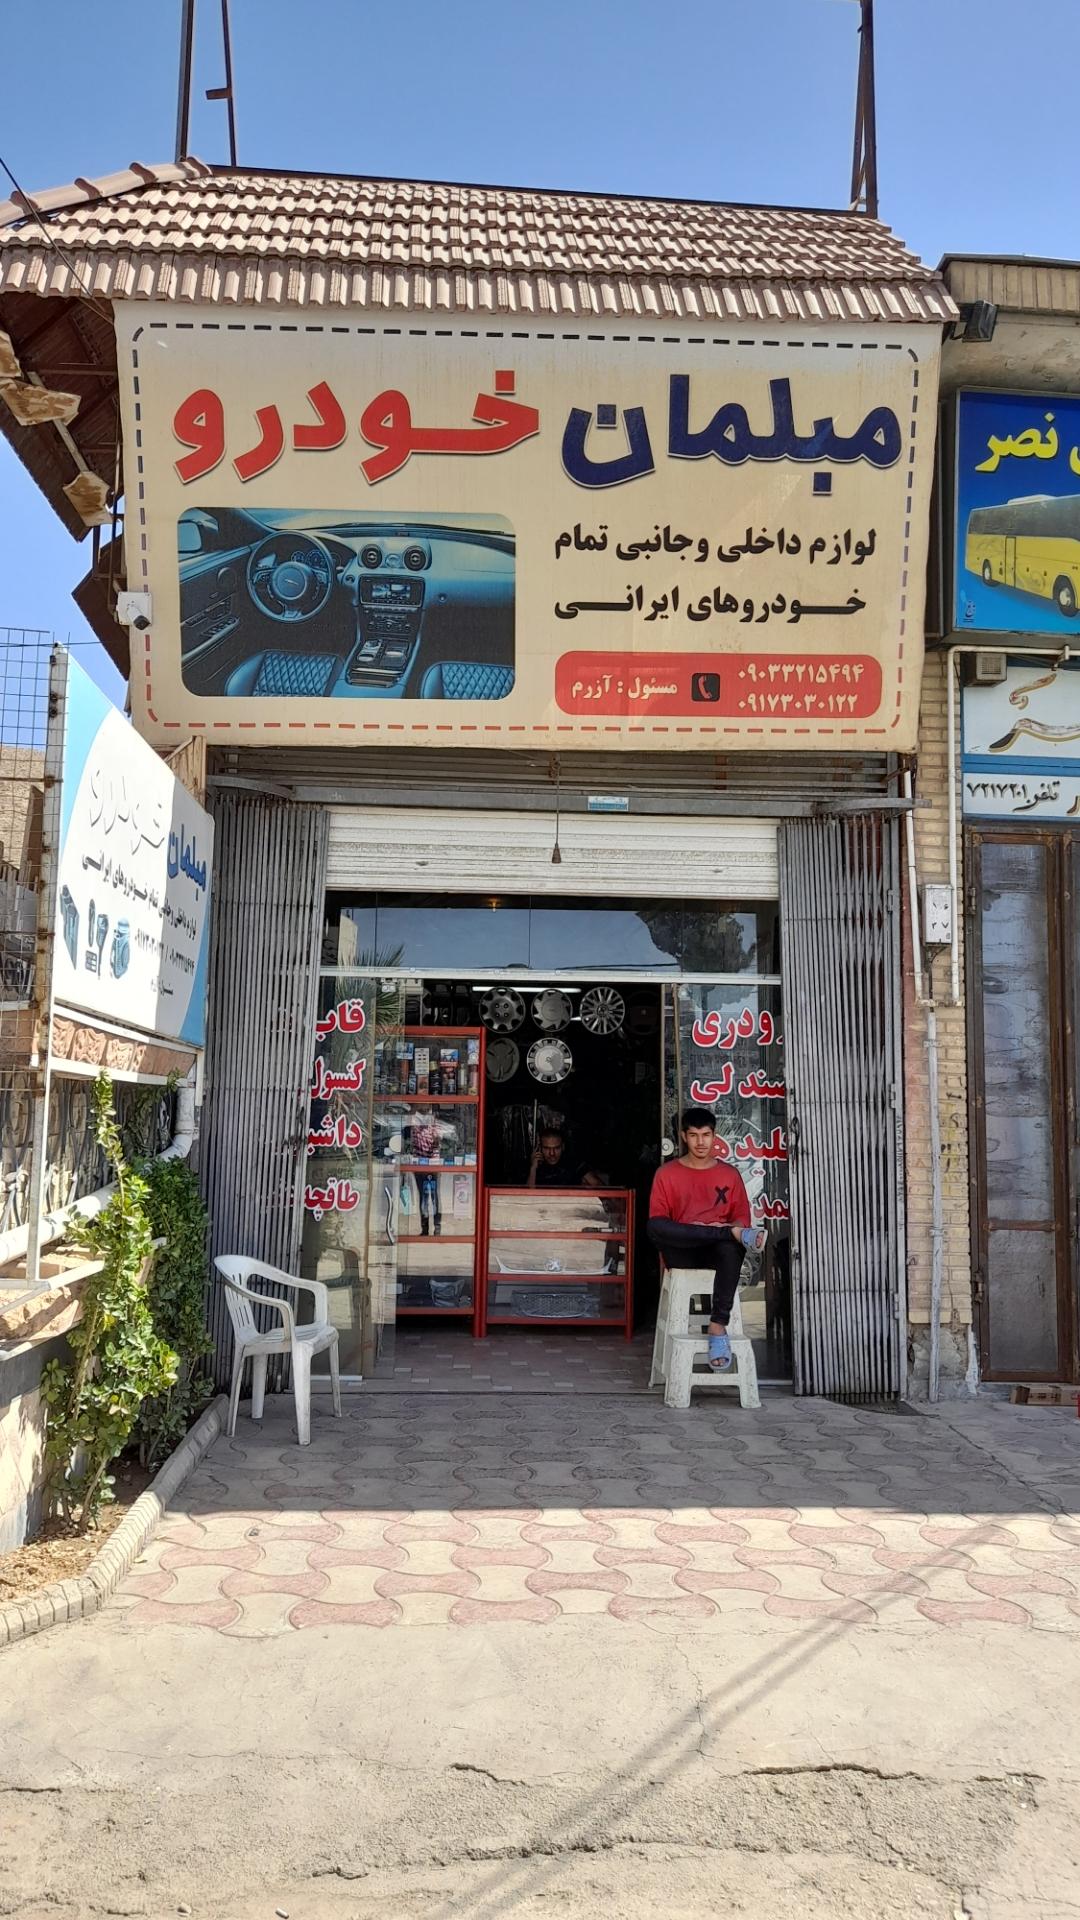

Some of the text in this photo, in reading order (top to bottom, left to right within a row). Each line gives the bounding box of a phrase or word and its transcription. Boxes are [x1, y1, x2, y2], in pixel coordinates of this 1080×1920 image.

[172, 370, 902, 496] مبلمان خودرو
[974, 412, 1059, 473] نصر
[555, 523, 608, 559] تمام
[717, 527, 801, 563] داخلی
[809, 528, 877, 565] لوازم
[554, 584, 867, 623] خودروهای ایرانی
[571, 674, 612, 699] آزرم
[628, 676, 678, 699] مسئول
[738, 663, 864, 684] ۰۹۰۳۳۲۱۵۴۹۴
[738, 693, 858, 713] ۰۹۱۷۳۰۳۰۱۲۲
[1012, 780, 1060, 812] تلفن
[167, 823, 207, 901] مبلمان
[311, 1056, 366, 1100] کنسول
